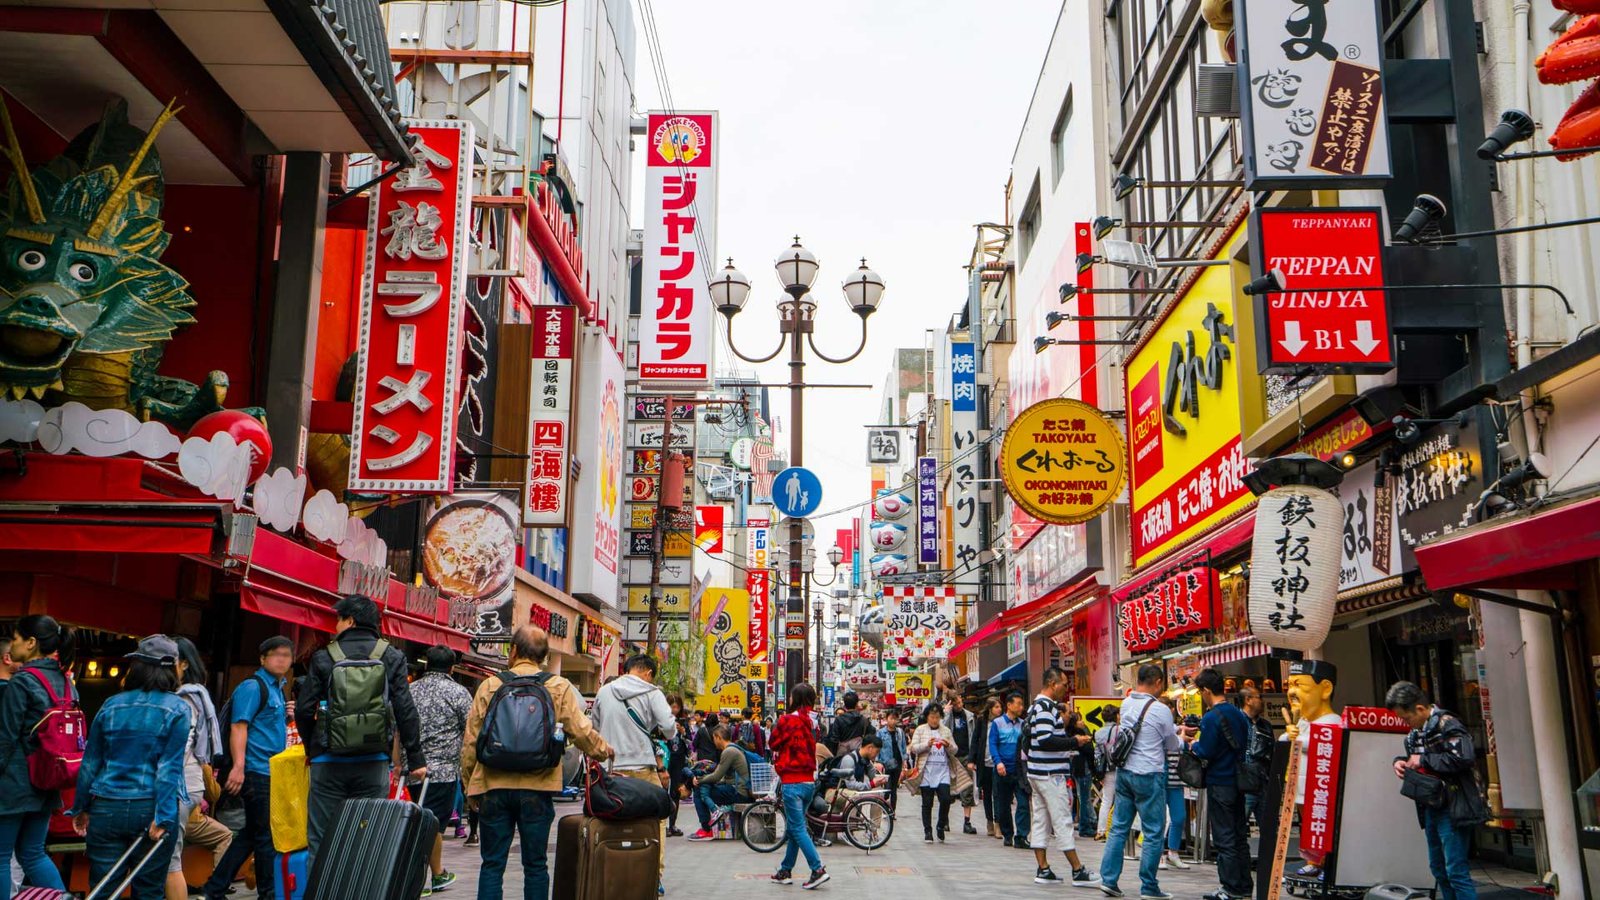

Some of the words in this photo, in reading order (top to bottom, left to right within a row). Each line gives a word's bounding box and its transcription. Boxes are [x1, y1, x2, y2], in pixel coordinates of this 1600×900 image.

[1292, 218, 1371, 229] TEPPANYAKI
[655, 173, 697, 361] ジャンカラ
[1269, 256, 1376, 276] TEPPAN
[365, 132, 453, 471] 金龍ラーメン
[1271, 290, 1369, 309] JINJYA
[545, 308, 562, 358] 大起水産
[1313, 329, 1345, 350] B1
[543, 360, 559, 409] 回転寿司
[952, 353, 976, 402] 焼肉
[1043, 418, 1086, 431] たこ焼
[872, 436, 896, 457] 牛角
[1032, 433, 1097, 443] TAKOYAKI
[529, 419, 565, 514] 四海樓
[1017, 448, 1116, 473] くれおーる
[1024, 480, 1108, 491] OKONOMIYAKI
[954, 428, 977, 572] いろりや
[1038, 492, 1094, 506] お好み焼
[1140, 497, 1172, 547] 大阪名物
[751, 573, 764, 651] ツルハドラッグ
[900, 601, 939, 614] 道頓堀
[887, 614, 952, 630] ぷりくら
[1358, 711, 1377, 726] GO
[1380, 713, 1410, 727] dow
